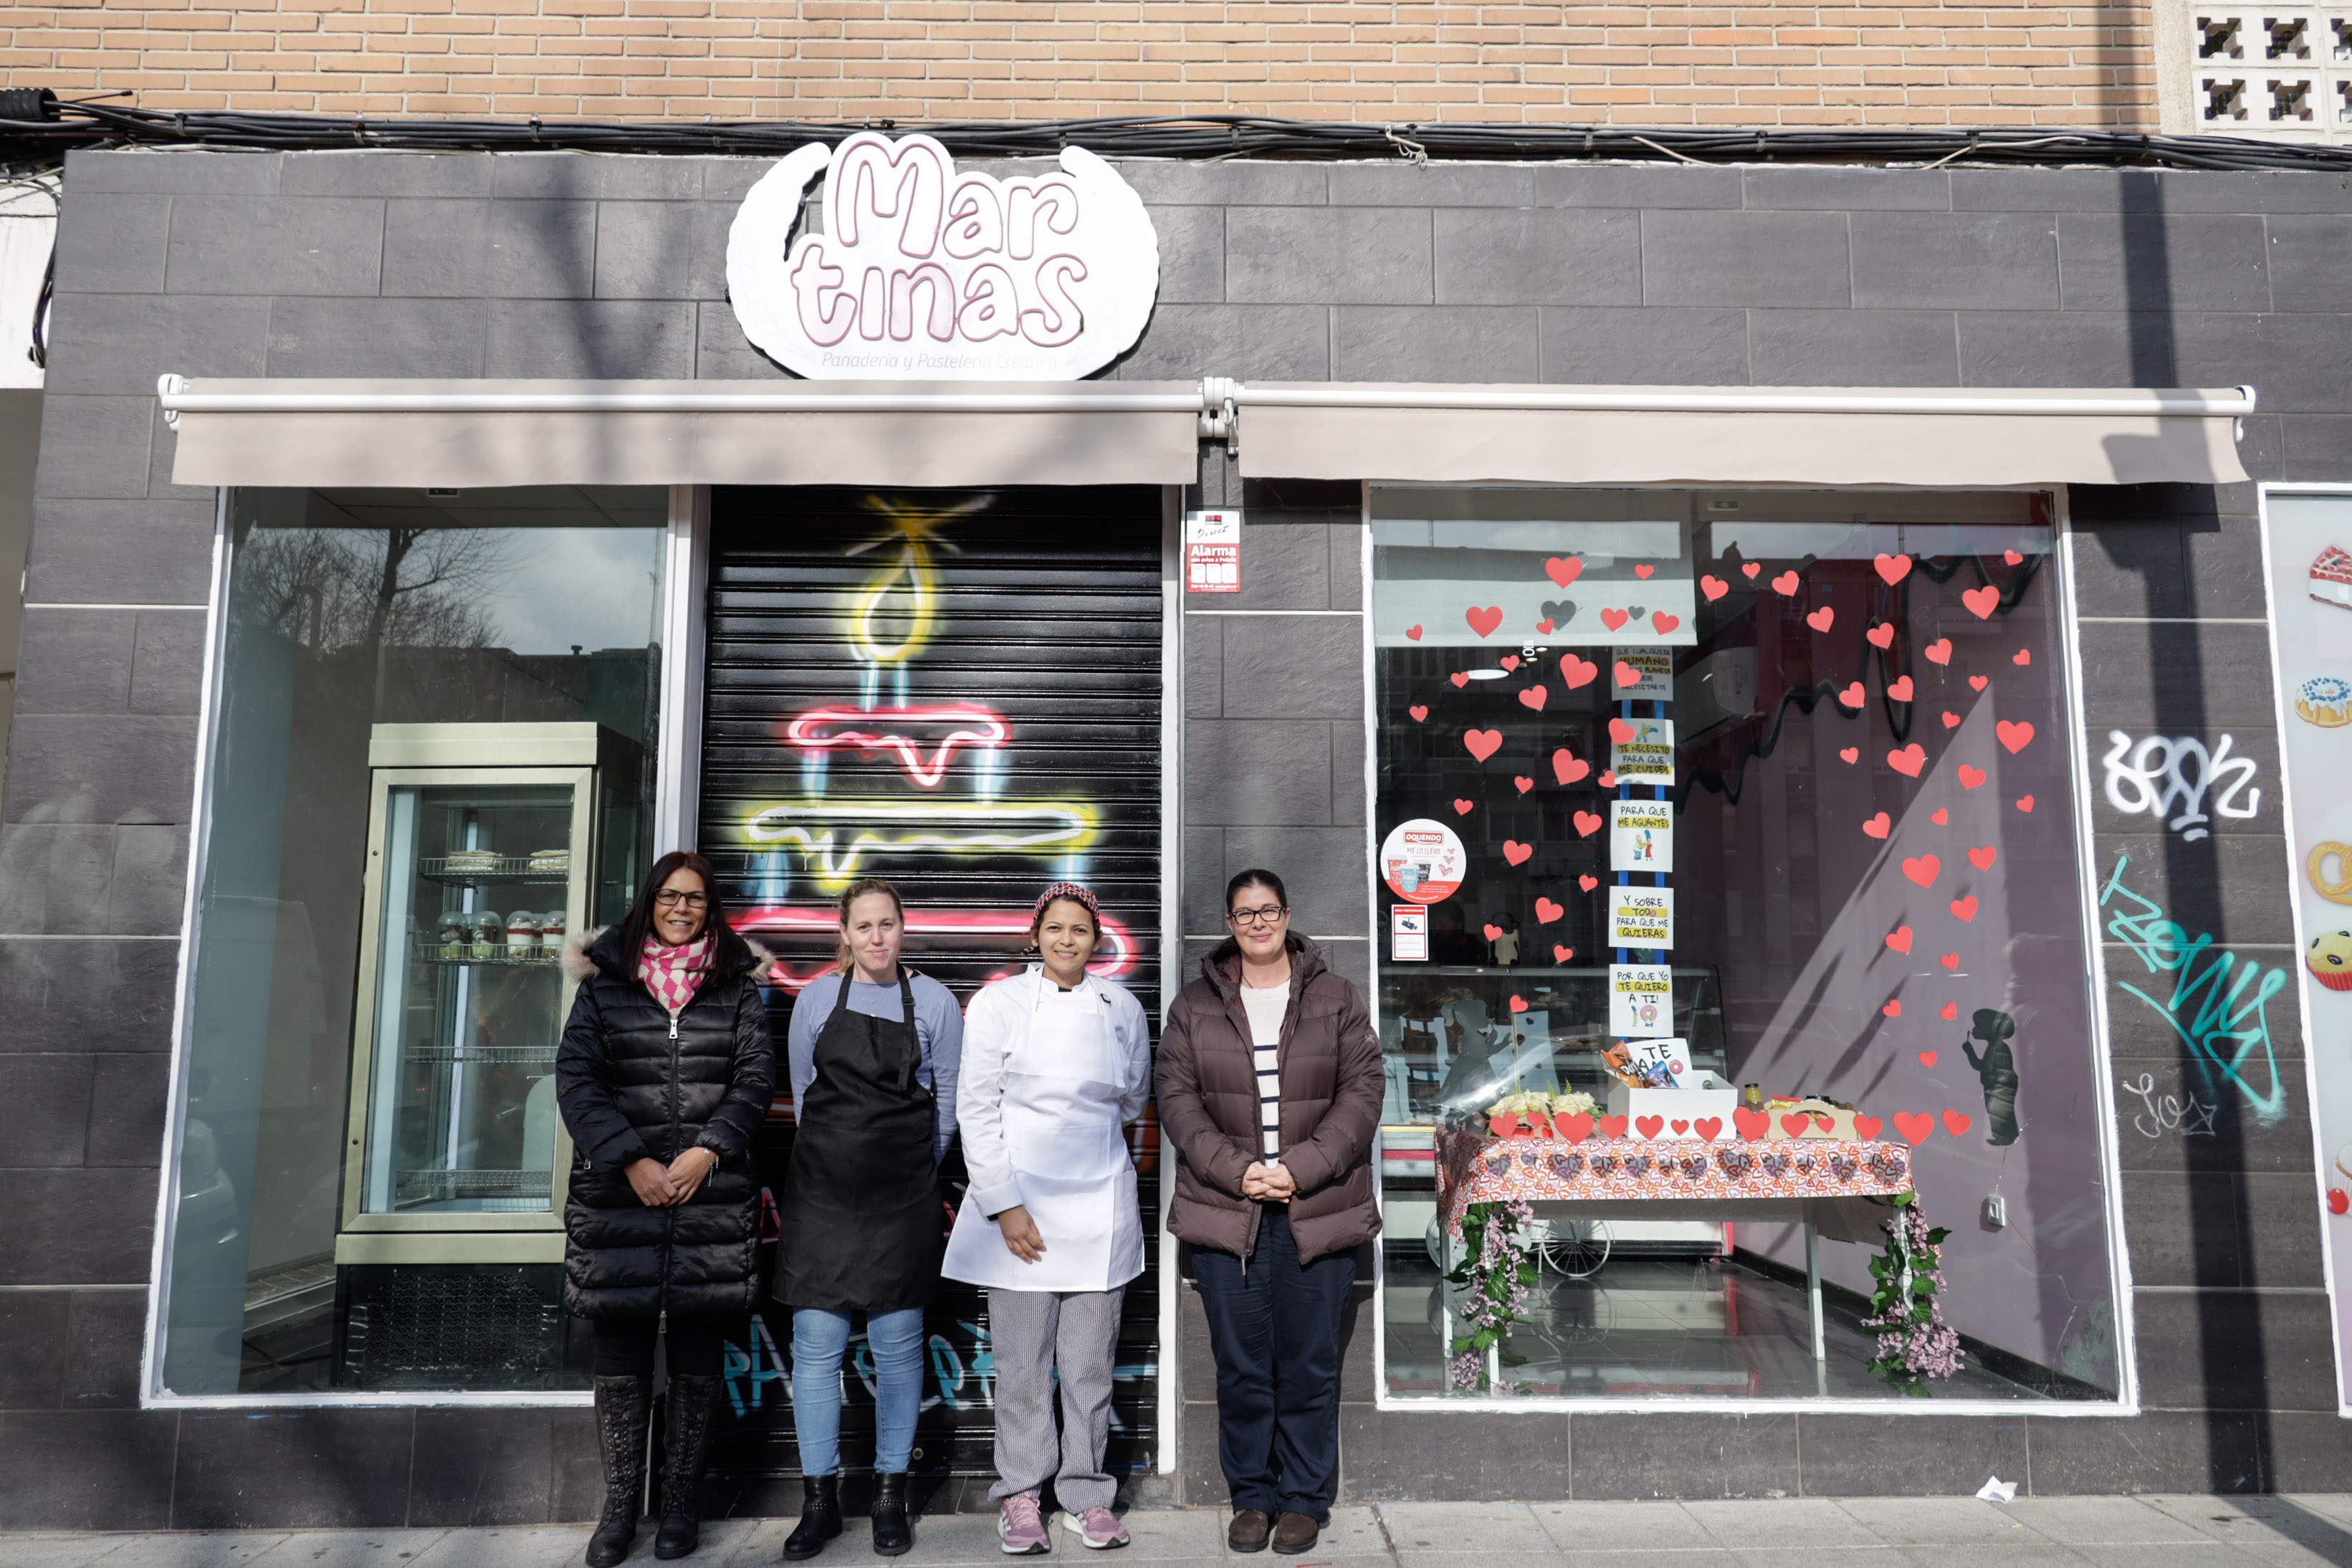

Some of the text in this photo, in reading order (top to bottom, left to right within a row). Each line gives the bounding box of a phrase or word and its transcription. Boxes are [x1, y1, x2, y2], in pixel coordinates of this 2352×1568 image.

[835, 140, 1079, 259] Mar
[790, 242, 1088, 347] tinas
[822, 352, 898, 368] Panadería
[903, 355, 912, 371] y
[1190, 544, 1237, 556] Alarma
[1632, 745, 1670, 754] NECESITO
[1636, 765, 1669, 774] CUIDES
[1620, 806, 1667, 816] PARA QUE
[1618, 818, 1670, 828] ME AGUANTES
[1623, 895, 1663, 907] Y SOBRE
[1617, 917, 1636, 926] PARA
[1640, 918, 1655, 927] QUE
[1622, 927, 1665, 938] QUIERAS
[1617, 971, 1669, 981] POR QUE YO
[1635, 982, 1668, 992] QUIERO
[1628, 993, 1659, 1003] A TI!
[1642, 1044, 1671, 1059] TE
